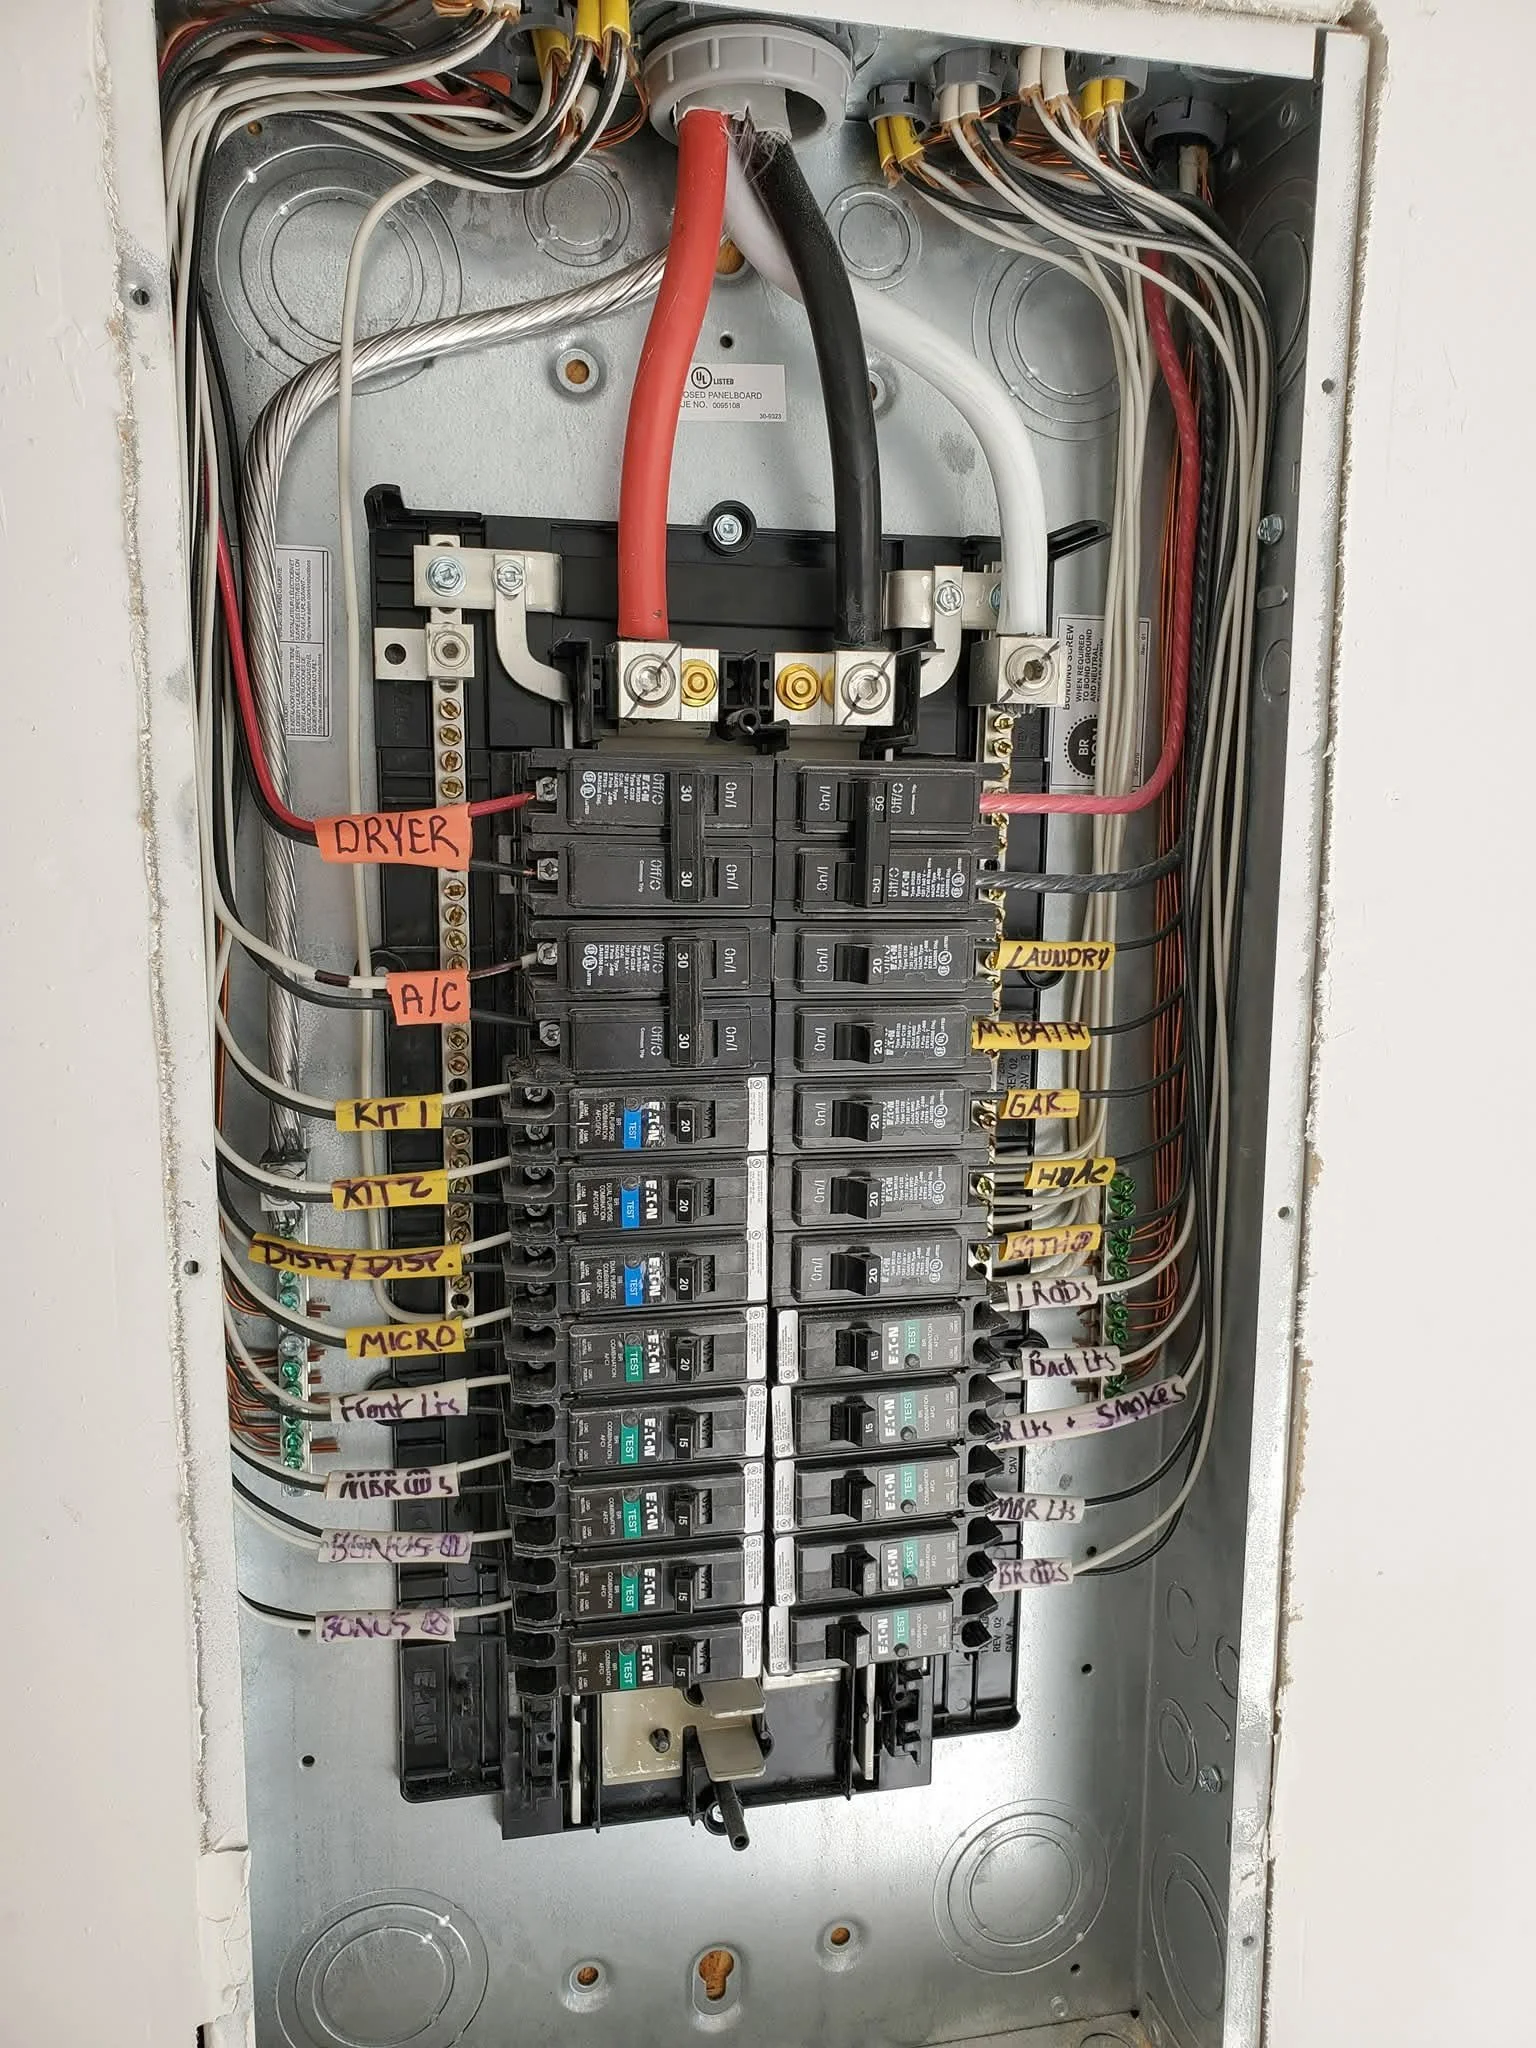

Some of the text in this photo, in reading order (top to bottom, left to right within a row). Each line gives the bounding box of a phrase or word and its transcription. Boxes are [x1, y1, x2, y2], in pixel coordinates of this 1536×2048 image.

[682, 391, 763, 400] OSED PANELBOARD
[693, 400, 708, 409] NO.
[1075, 634, 1085, 703] WHEN REQUIRED
[1082, 629, 1093, 703] TO BOND GROUND
[1078, 739, 1089, 756] BR
[680, 785, 693, 802] 30
[875, 796, 885, 812] 50
[334, 813, 459, 858] DRYER
[681, 871, 693, 887] 30
[872, 878, 881, 893] 50
[677, 952, 689, 969] 30
[873, 958, 882, 974] 20
[1005, 945, 1110, 970] LAUNDRY
[401, 976, 461, 1017] A/C
[678, 1033, 690, 1049] 30
[1015, 1020, 1088, 1045] BATH
[874, 1039, 883, 1055] 20
[1006, 1057, 1018, 1089] REV 02
[354, 1099, 427, 1129] KIT 1
[647, 1101, 661, 1141] EATON
[680, 1119, 691, 1133] 20
[871, 1114, 879, 1129] 20
[628, 1121, 637, 1140] TEST
[342, 1180, 395, 1209] KIT
[645, 1180, 658, 1219] EATON
[679, 1199, 689, 1212] 20
[870, 1192, 878, 1207] 20
[626, 1200, 635, 1219] TEST
[629, 1278, 638, 1296] TEST
[647, 1257, 661, 1297] EATON
[679, 1277, 689, 1291] 20
[869, 1268, 878, 1283] 20
[359, 1325, 455, 1357] MICRO
[888, 1326, 900, 1364] EATON
[907, 1326, 916, 1350] TEST
[610, 1339, 618, 1378] COMBINATION
[630, 1351, 639, 1376] TEST
[648, 1334, 661, 1374] EATON
[680, 1357, 690, 1371] 20
[871, 1350, 879, 1361] 15
[1029, 1350, 1078, 1377] Back
[339, 1392, 414, 1422] Front
[903, 1397, 912, 1422] TEST
[1095, 1382, 1186, 1428] Smokes
[865, 1423, 874, 1433] 15
[884, 1399, 895, 1437] EATON
[625, 1434, 634, 1458] TEST
[644, 1417, 657, 1456] EATON
[679, 1437, 689, 1447] 15
[1009, 1456, 1018, 1474] CAV
[885, 1474, 896, 1511] EATON
[904, 1471, 912, 1495] TEST
[646, 1492, 658, 1530] EATON
[864, 1499, 872, 1509] 15
[996, 1498, 1040, 1521] MBR
[628, 1508, 637, 1532] TEST
[678, 1515, 688, 1525] 15
[887, 1549, 898, 1586] EATON
[906, 1545, 914, 1569] TEST
[644, 1567, 656, 1605] EATON
[867, 1573, 875, 1583] 15
[626, 1584, 634, 1608] TEST
[678, 1592, 688, 1602] 15
[878, 1618, 889, 1654] EATON
[897, 1616, 905, 1638] TEST
[992, 1617, 1001, 1652] REV 02
[858, 1645, 867, 1655] 15
[624, 1660, 632, 1684] TEST
[642, 1644, 653, 1681] EATON
[676, 1667, 686, 1677] 15
